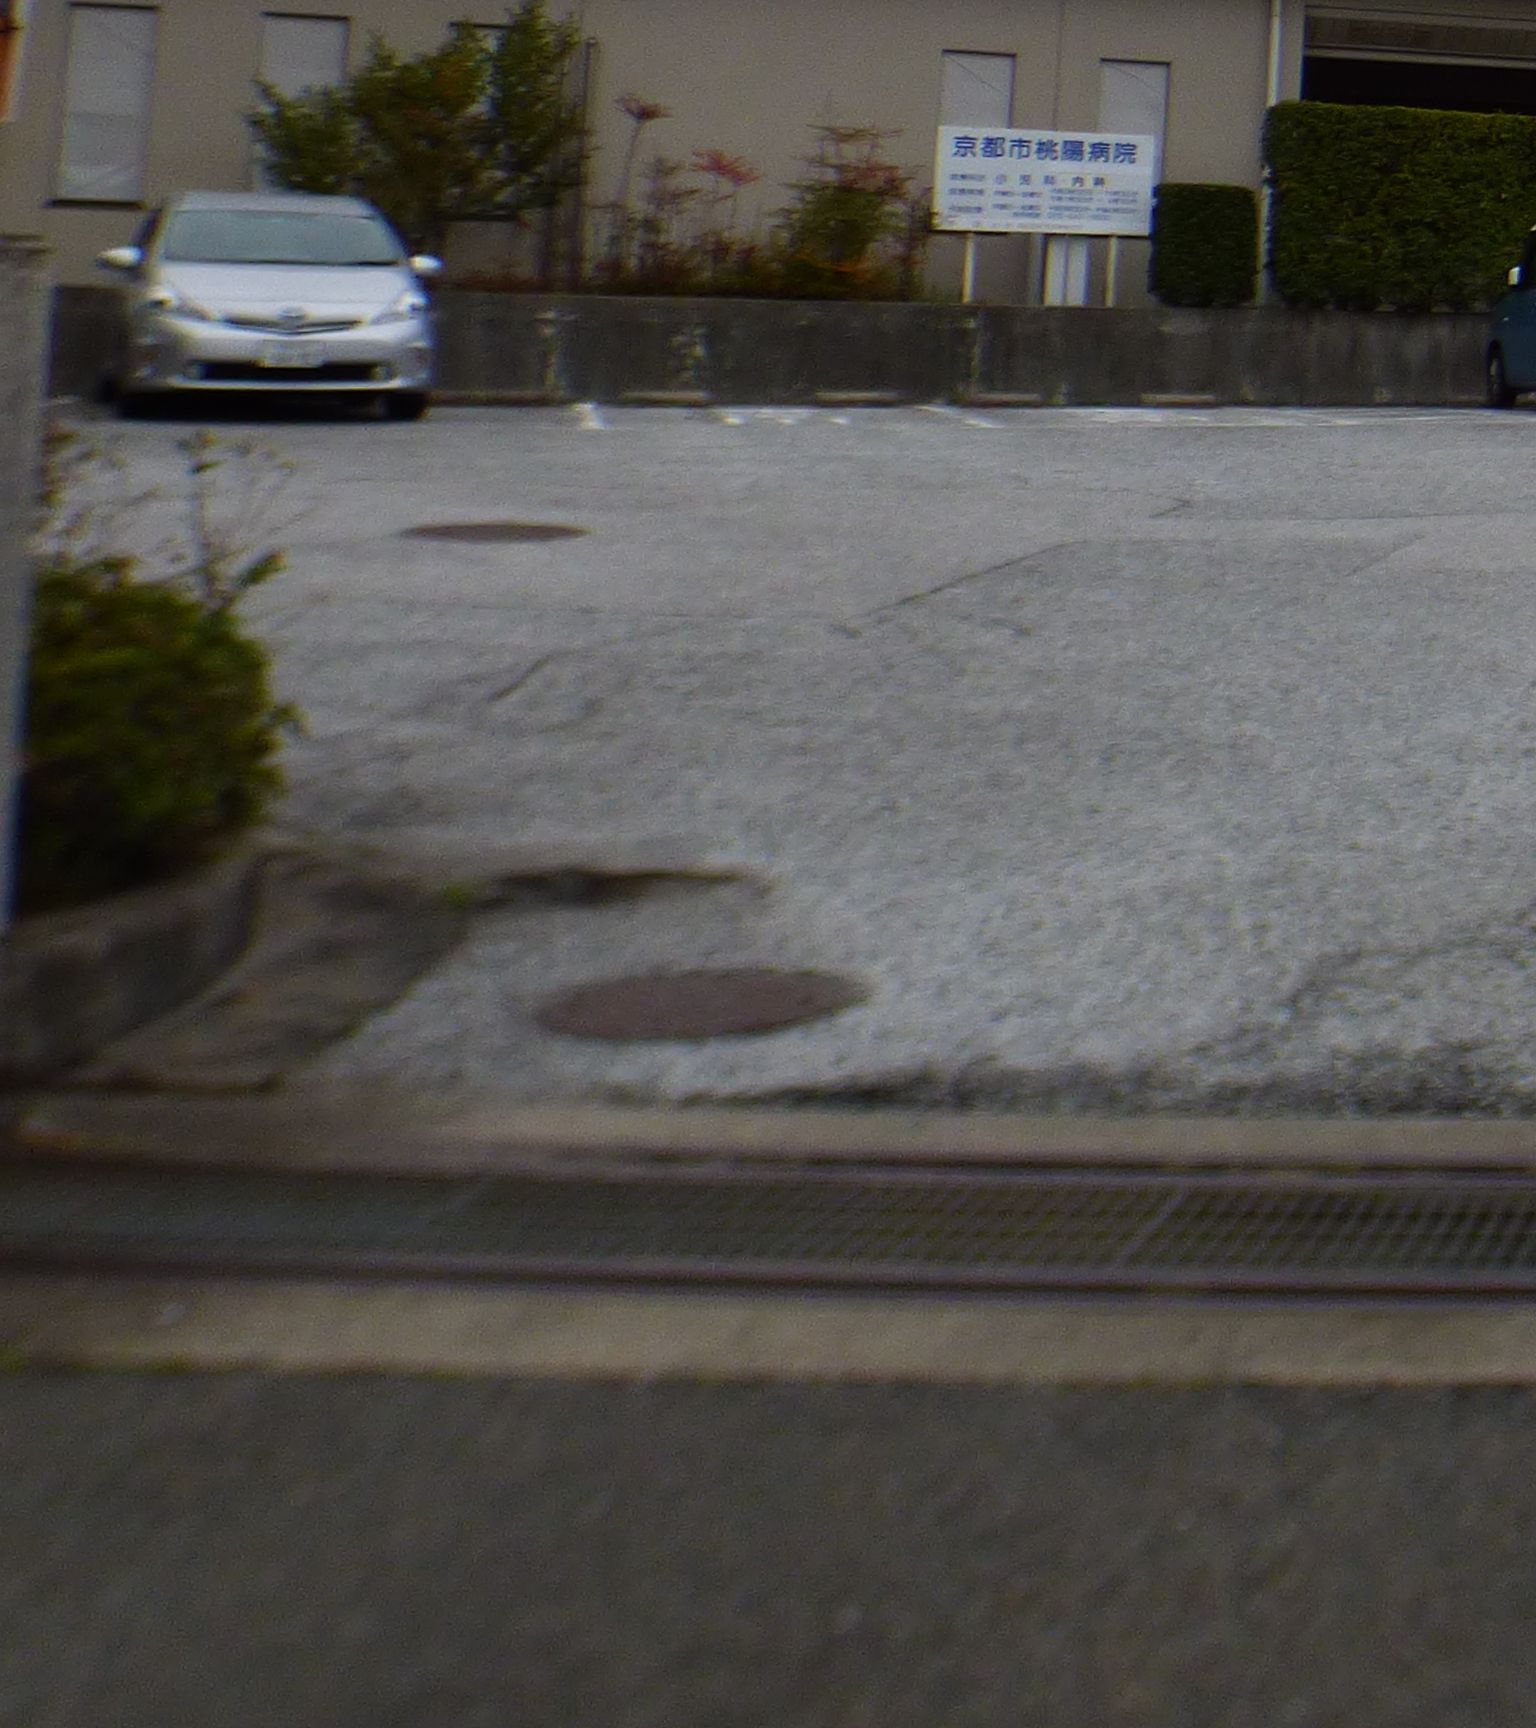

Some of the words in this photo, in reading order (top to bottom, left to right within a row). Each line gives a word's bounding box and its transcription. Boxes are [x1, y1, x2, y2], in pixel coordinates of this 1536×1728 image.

[952, 135, 1137, 164] 京都市桃陽病院
